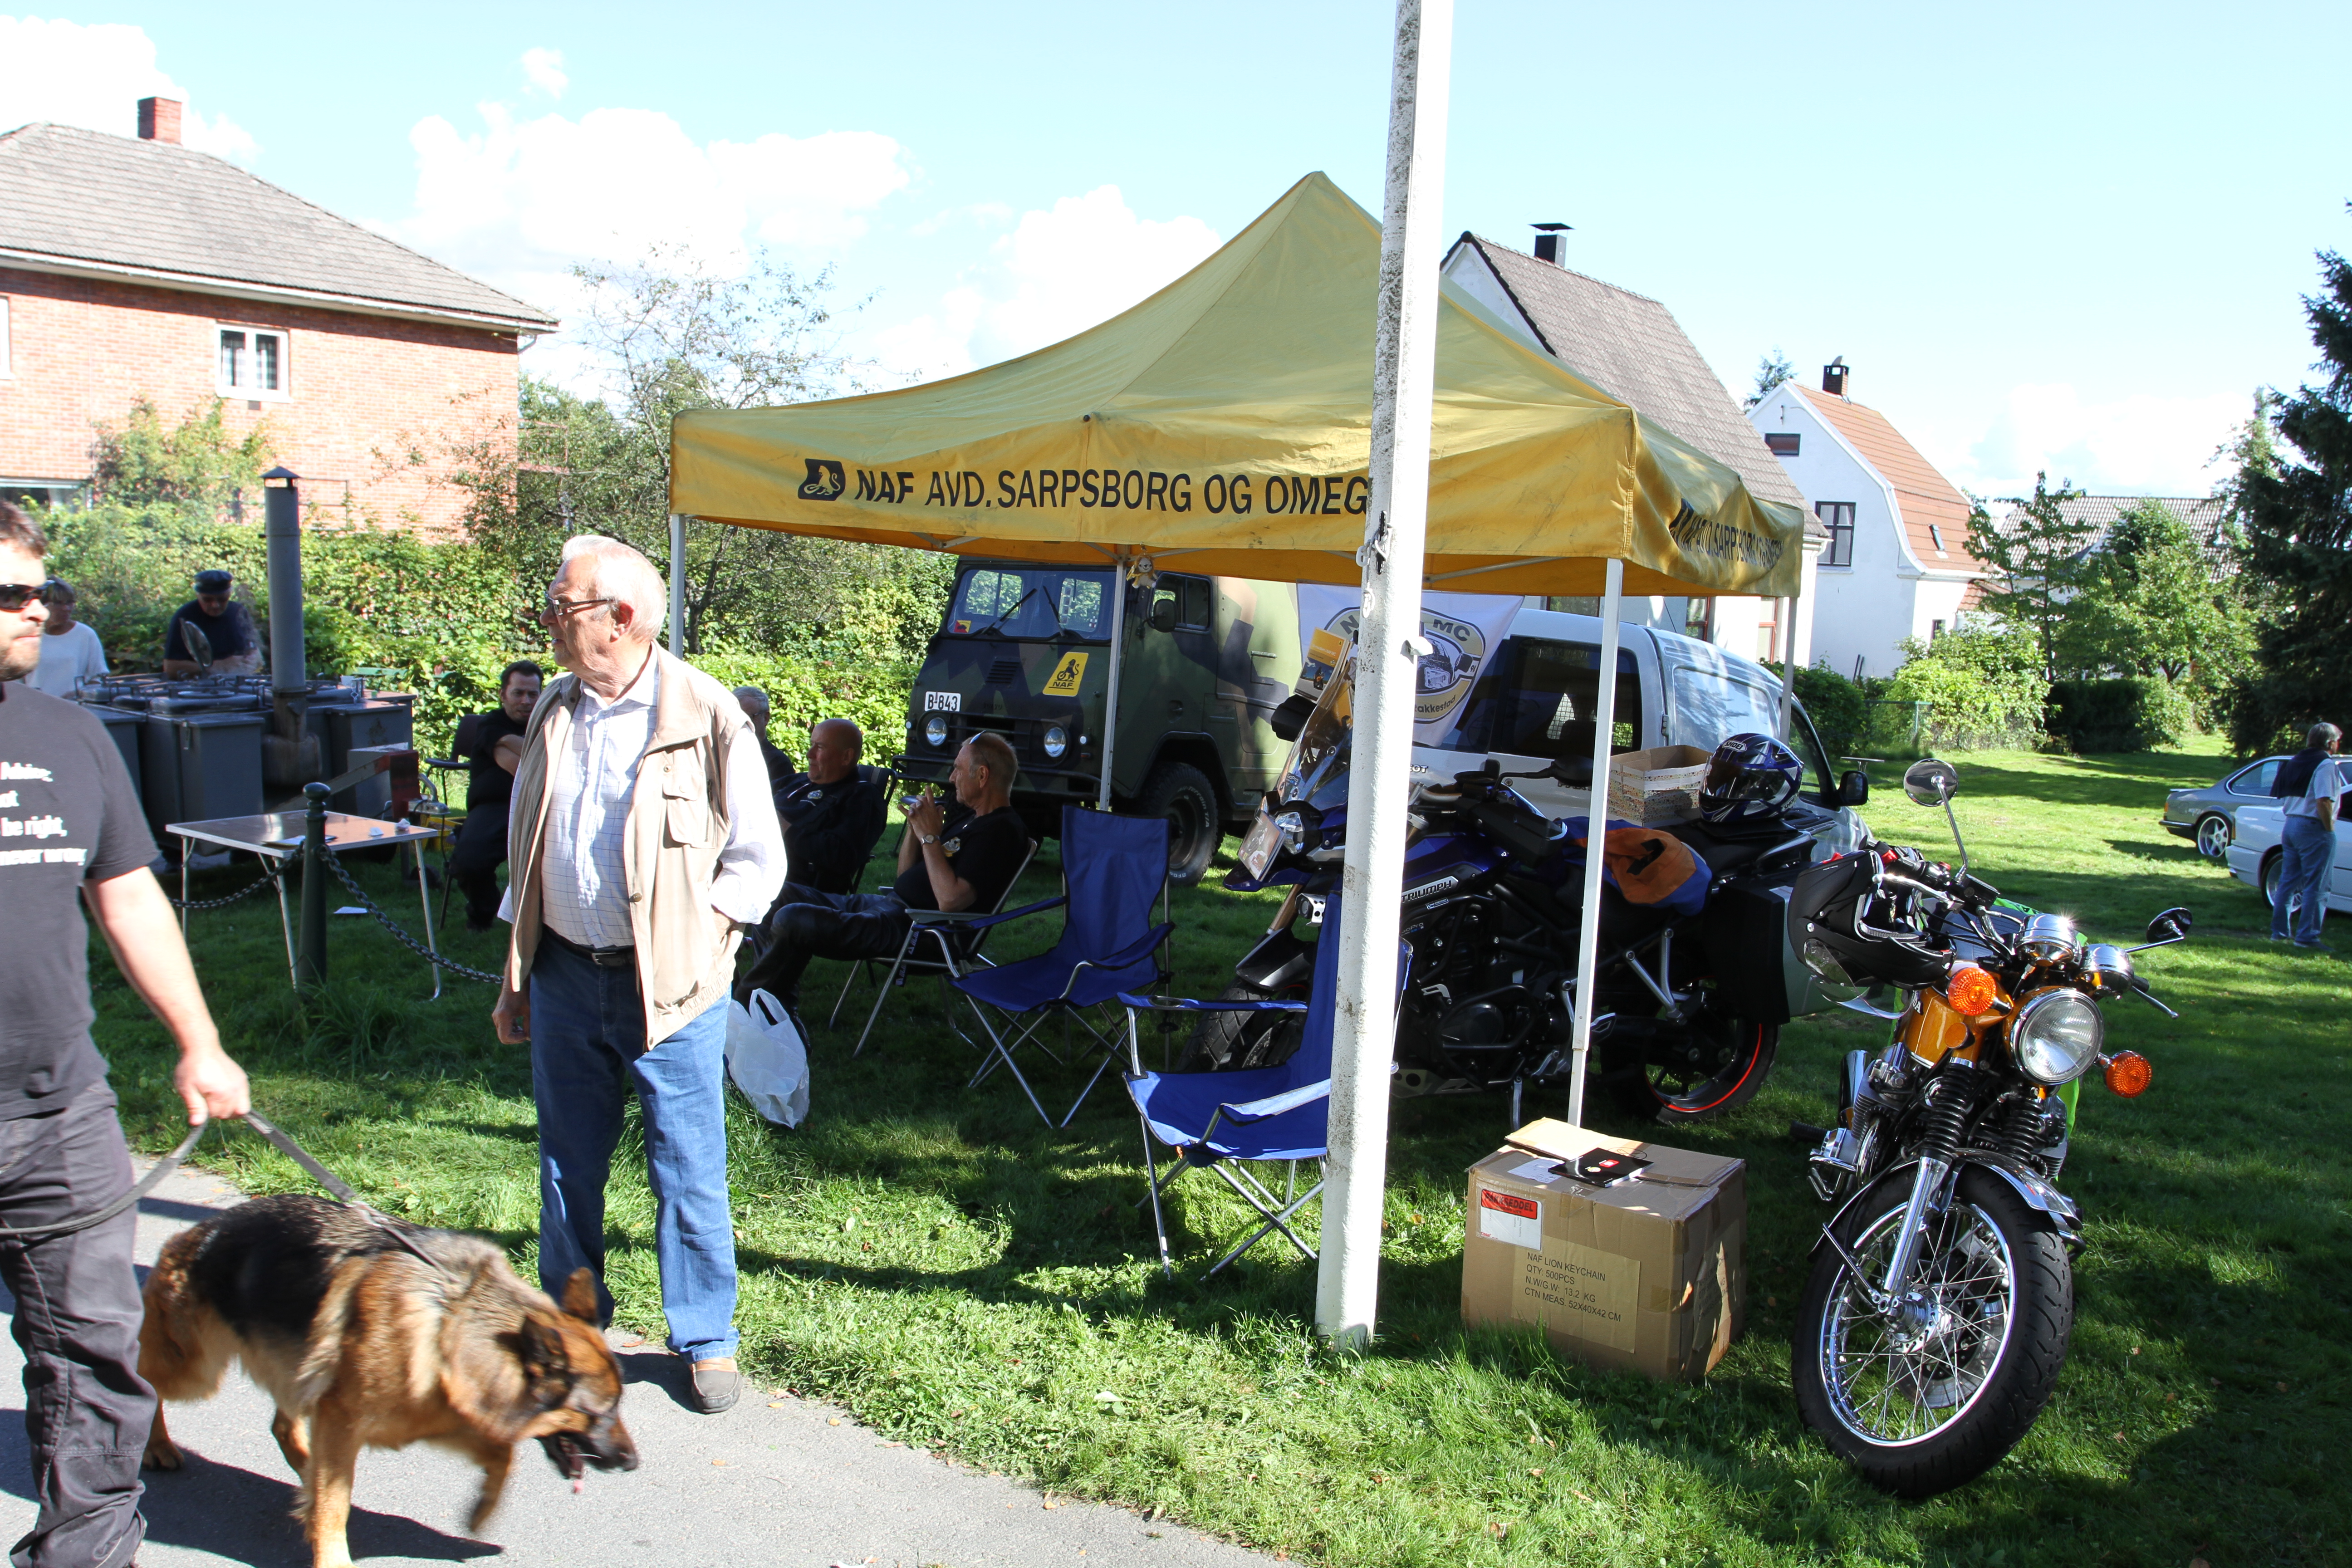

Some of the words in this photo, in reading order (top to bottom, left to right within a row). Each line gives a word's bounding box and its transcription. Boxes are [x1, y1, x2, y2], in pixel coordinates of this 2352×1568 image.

[855, 469, 914, 504] NAF
[997, 469, 1191, 512] SARPSBORG
[1204, 474, 1252, 514] OG
[1266, 475, 1368, 515] OMEG
[1433, 619, 1470, 642] MC
[1725, 741, 1744, 750] SHOEI
[1402, 880, 1451, 902] TRIUMPH
[1526, 1264, 1544, 1276] QTY:
[1546, 1270, 1575, 1285] 500PCS
[1527, 1252, 1543, 1263] NAF
[1544, 1257, 1563, 1269] LION
[1565, 1263, 1605, 1282] KEYCHAIN
[1526, 1275, 1560, 1293] N.W/G.W:
[1565, 1288, 1580, 1298] 13.2
[1584, 1292, 1596, 1303] KG
[1525, 1287, 1540, 1298] CTN
[1543, 1293, 1567, 1307] MEAS.
[1568, 1300, 1606, 1318] 52X40X42
[1608, 1311, 1621, 1322] CM
